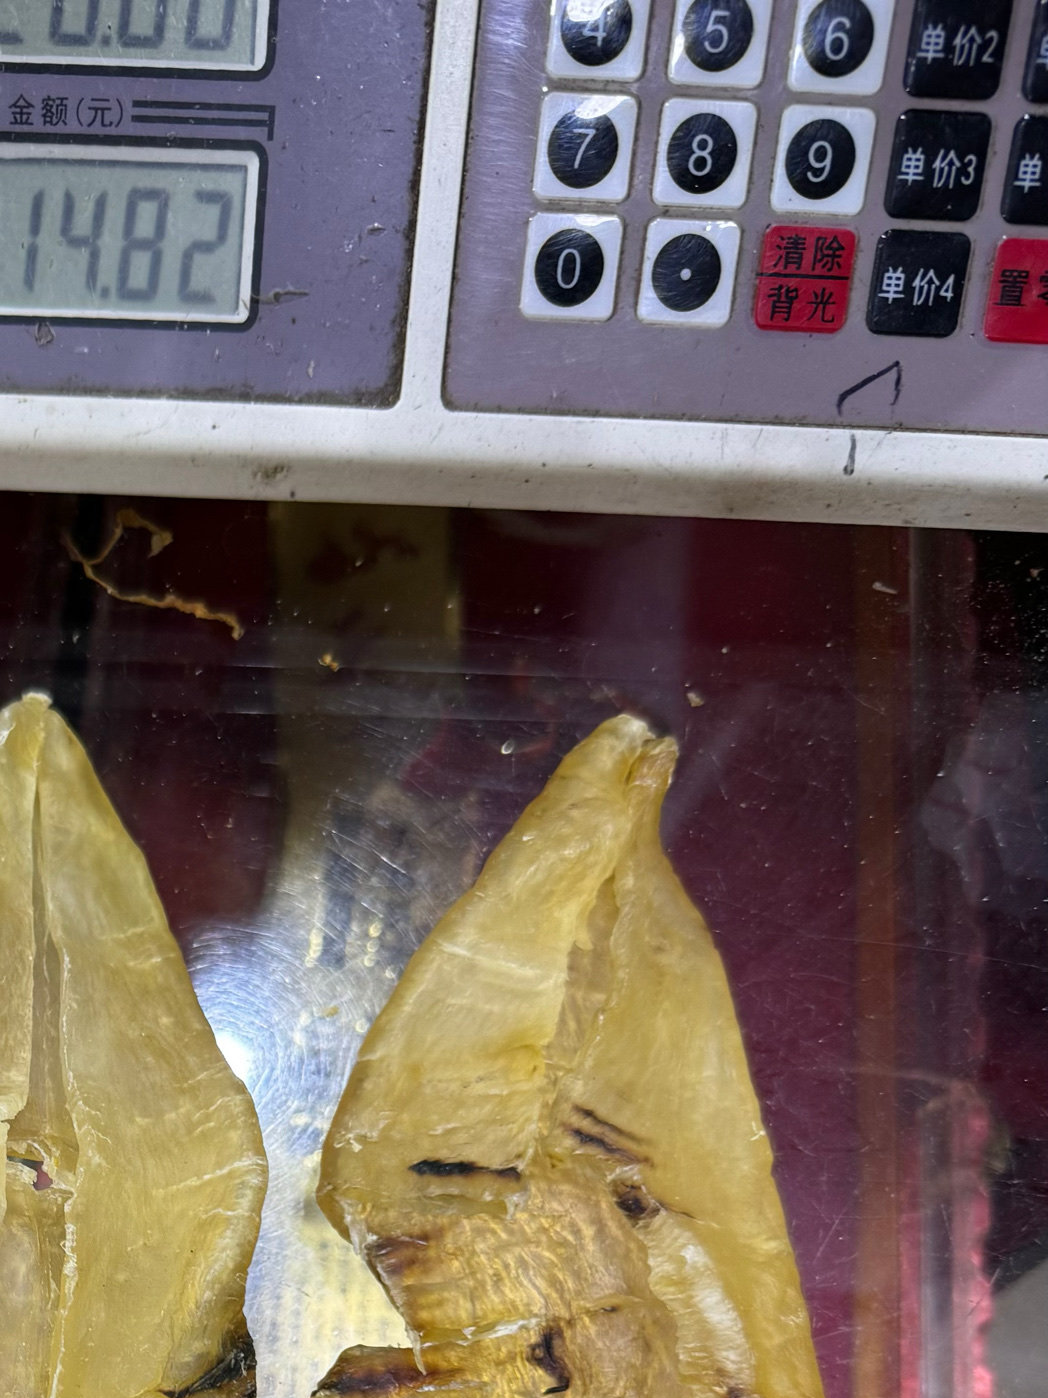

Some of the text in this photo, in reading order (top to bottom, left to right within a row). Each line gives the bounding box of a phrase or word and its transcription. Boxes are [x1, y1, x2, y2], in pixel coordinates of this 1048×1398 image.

[581, 9, 608, 47] 4
[703, 11, 730, 53] 5
[824, 17, 851, 61] 6
[916, 23, 999, 67] 单价2
[7, 93, 126, 129] 金额(元)
[571, 127, 597, 169] 7
[688, 134, 713, 176] 8
[806, 141, 834, 183] 9
[897, 146, 978, 189] 单价3
[556, 248, 582, 289] 0
[772, 234, 845, 272] 清除
[767, 284, 836, 324] 背光
[878, 266, 956, 307] 单价4
[993, 267, 1048, 308] 置
